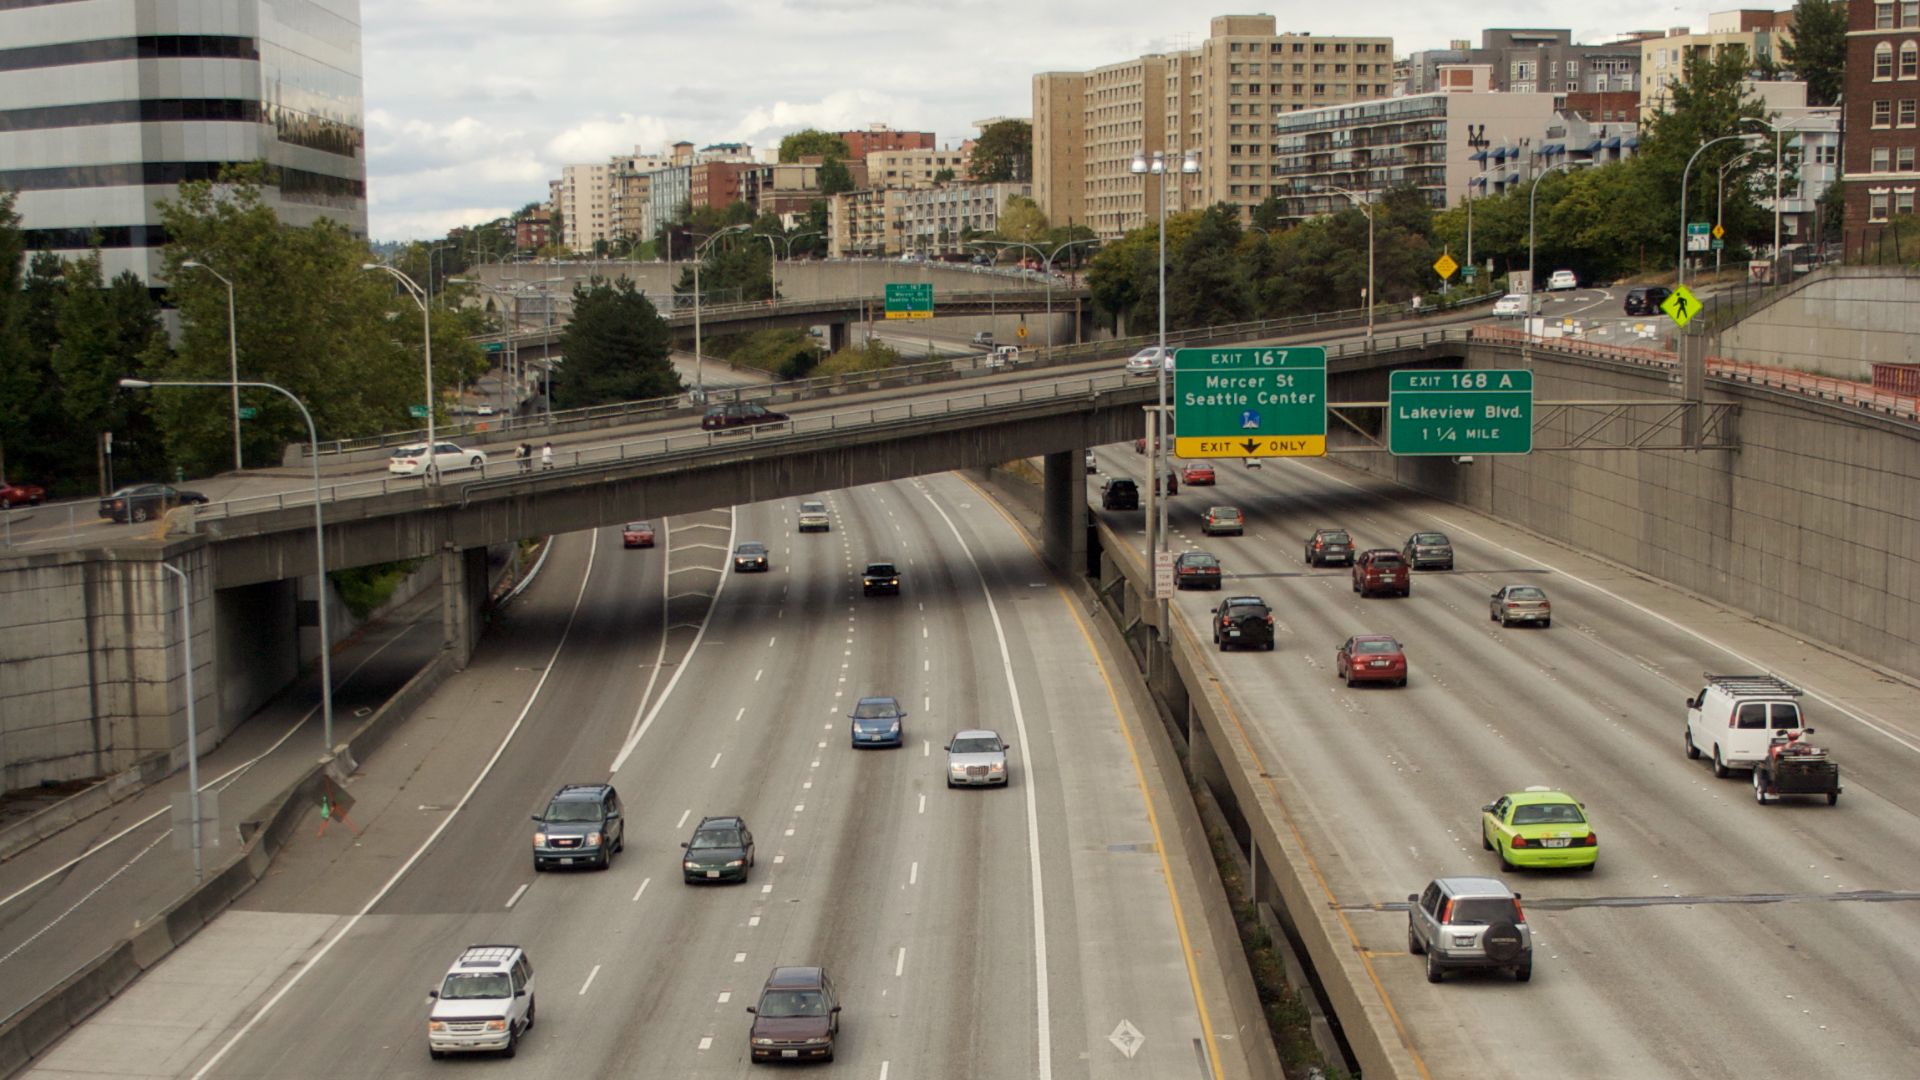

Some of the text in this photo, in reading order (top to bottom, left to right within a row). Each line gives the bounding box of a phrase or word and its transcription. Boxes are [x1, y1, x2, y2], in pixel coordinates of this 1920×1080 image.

[1211, 350, 1289, 366] EXIT 167
[1206, 373, 1294, 389] Mercer St
[1409, 373, 1513, 389] EXIT 168 A
[1185, 391, 1316, 406] Seattle Center
[1399, 404, 1523, 419] Lakeview Blvd.
[1422, 428, 1428, 440] 1
[1466, 428, 1500, 439] MILE
[1200, 440, 1307, 452] EXIT ONLY
